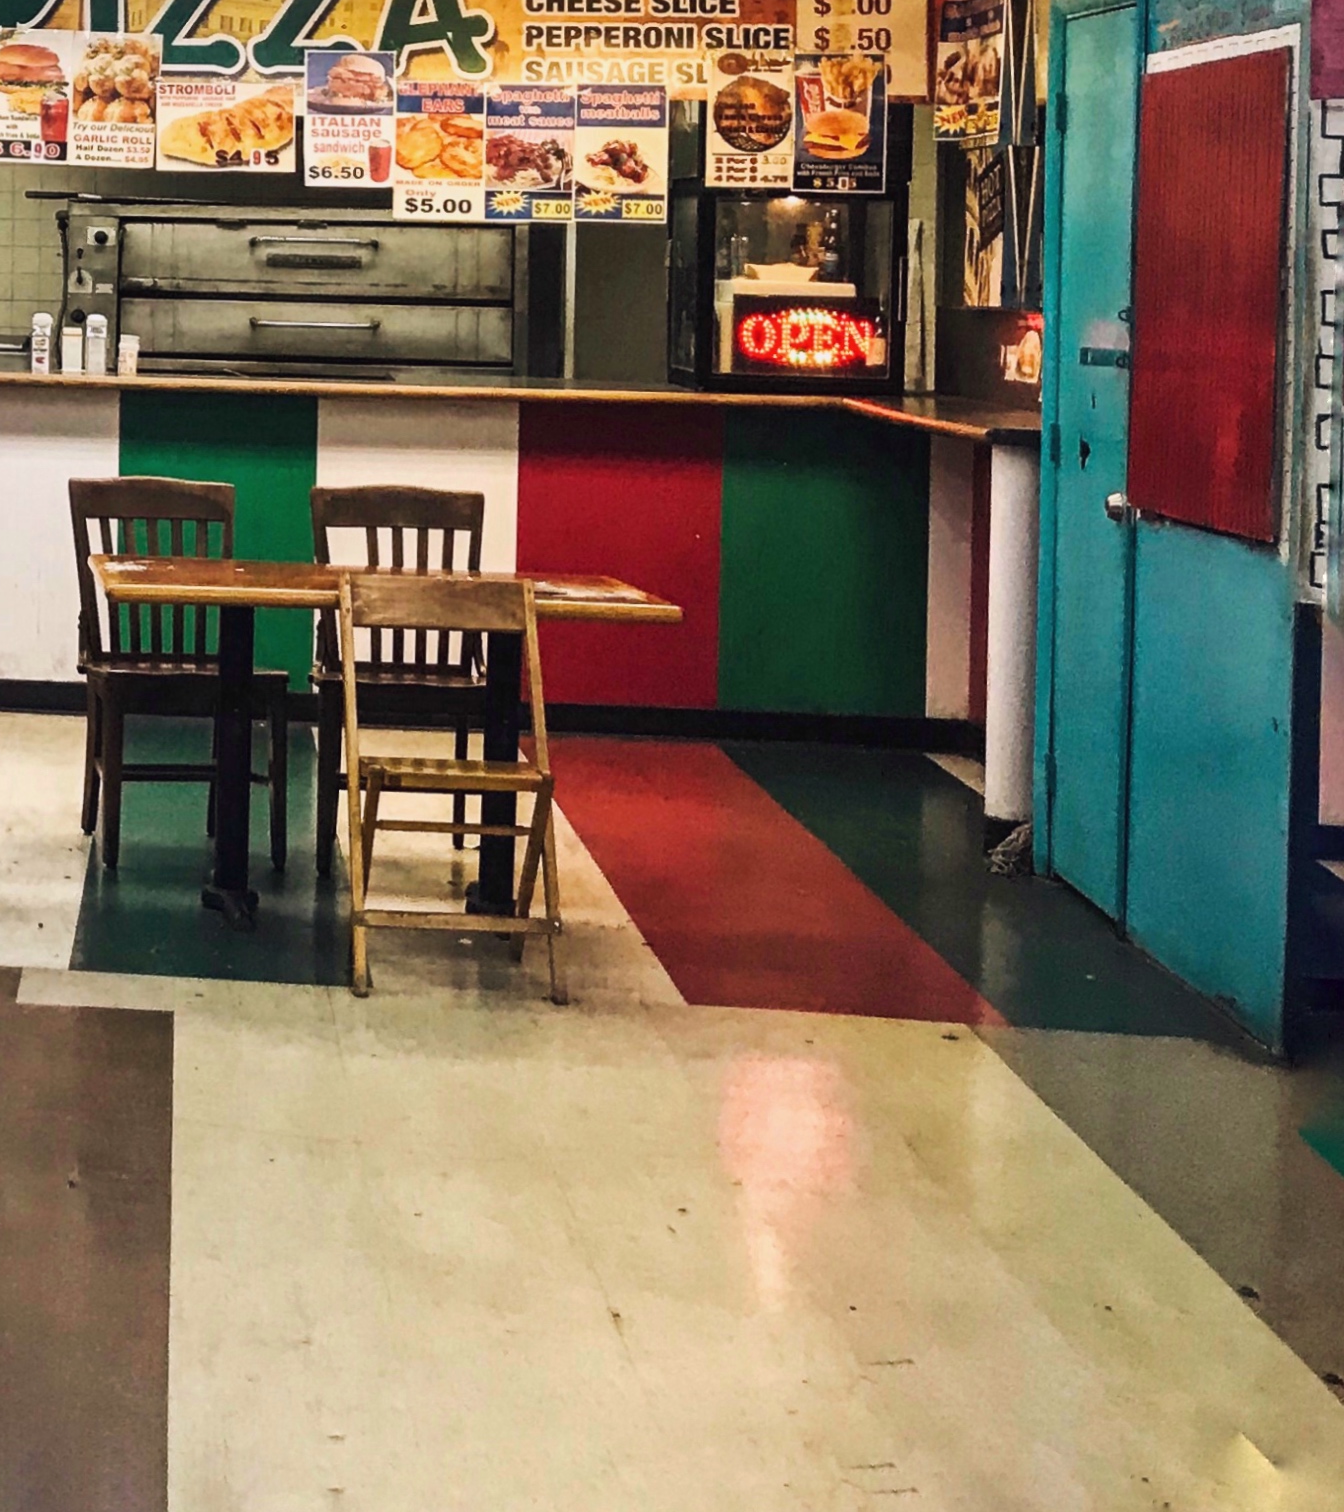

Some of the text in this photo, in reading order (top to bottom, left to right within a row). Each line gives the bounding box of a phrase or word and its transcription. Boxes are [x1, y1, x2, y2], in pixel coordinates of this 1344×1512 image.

[526, 25, 790, 51] PEPPERONI SLICE
[814, 28, 892, 51] $.50
[525, 61, 663, 85] SAUSAGE
[159, 84, 236, 95] STROMBOLI
[580, 92, 661, 106] Spaghetti
[421, 98, 465, 113] EARS
[581, 107, 661, 121] meatballs
[73, 121, 155, 133] Try our Delicious
[311, 117, 381, 127] ITALIAN
[487, 116, 573, 127] meat sauce
[74, 134, 152, 145] GARLIC ROLL
[311, 128, 382, 141] sausage
[76, 144, 124, 153] Half Dozen
[313, 140, 365, 154] sandwich
[308, 166, 365, 180] $6.50
[405, 189, 437, 198] Only
[404, 198, 472, 215] $5.00
[495, 196, 523, 208] NEW
[583, 197, 612, 208] NEW
[534, 203, 571, 214] $7.00
[624, 203, 663, 215] $7.00
[742, 312, 873, 357] OPEN
